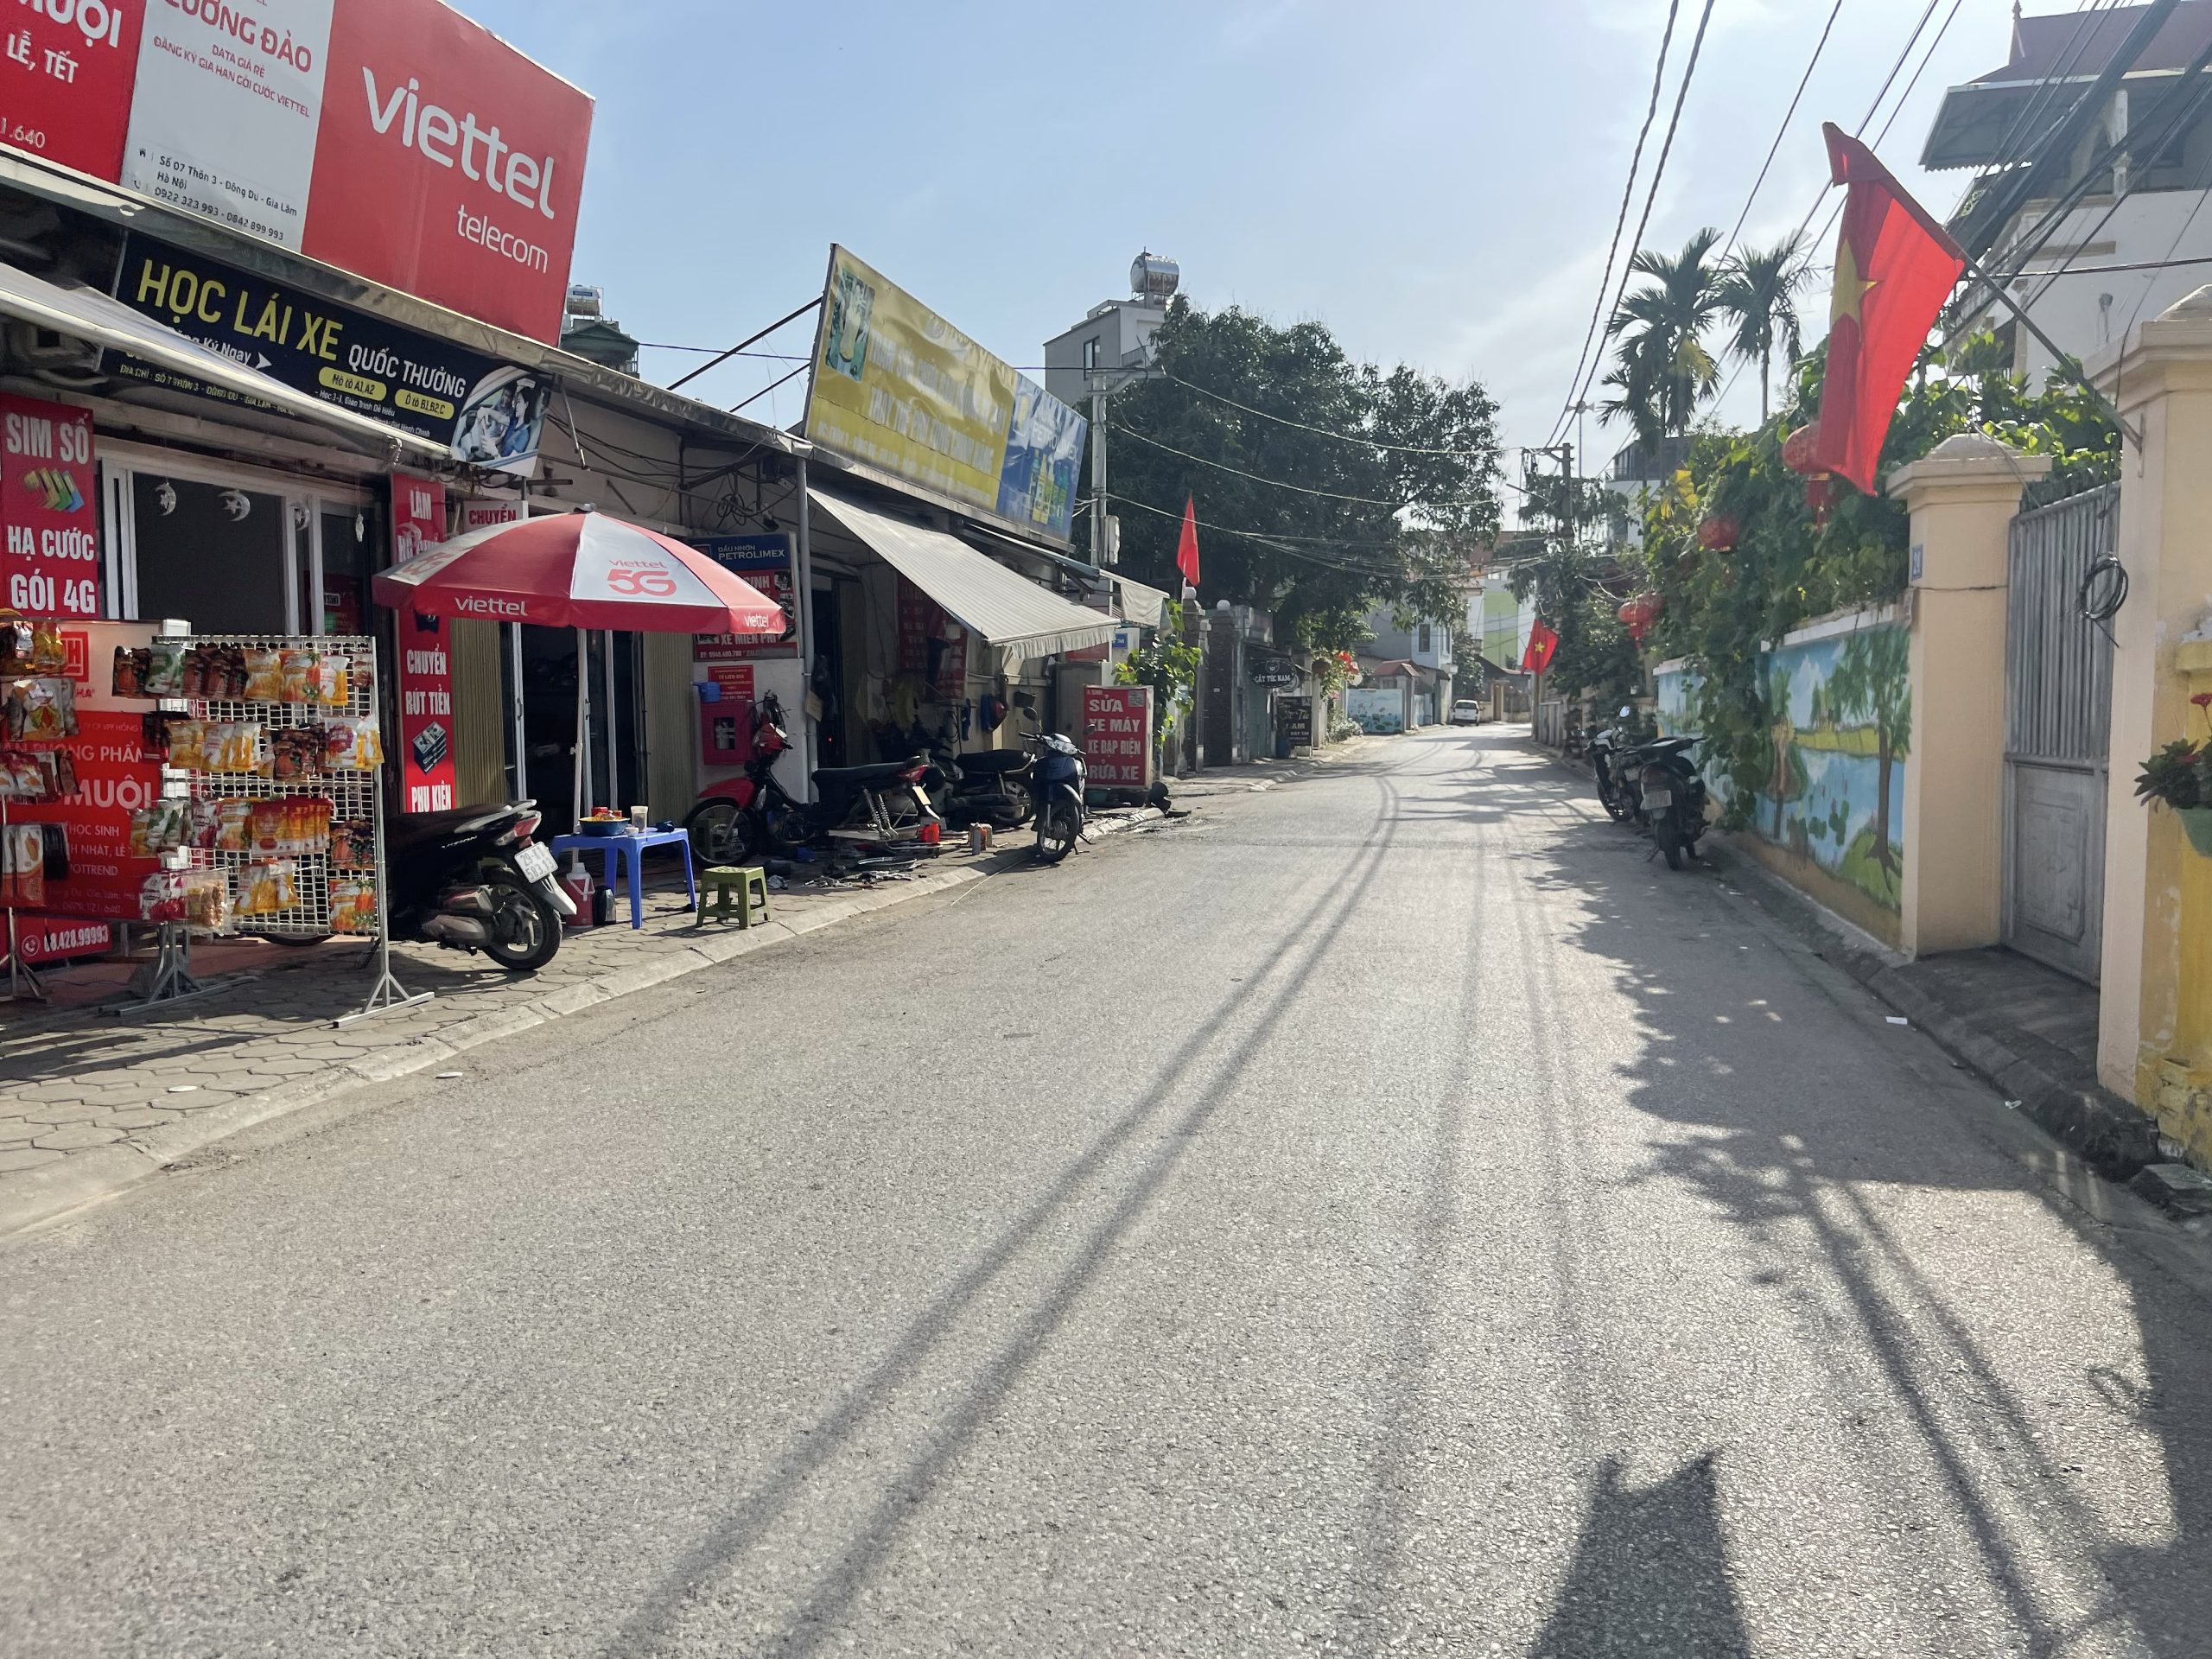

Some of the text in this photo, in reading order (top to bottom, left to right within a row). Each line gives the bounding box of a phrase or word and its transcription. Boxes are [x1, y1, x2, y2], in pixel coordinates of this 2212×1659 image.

[212, 44, 236, 64] DATA
[237, 57, 252, 73] GIÁ
[261, 29, 312, 73] ĐÀO
[44, 48, 79, 84] TẾT
[199, 57, 214, 71] GIA
[276, 93, 310, 118] VIETTEL
[362, 66, 554, 219] viettel
[157, 171, 169, 183] Hà
[159, 156, 171, 168] Số
[173, 161, 186, 172] 07
[188, 165, 209, 181] Thôn
[212, 175, 217, 185] 3
[265, 196, 278, 209] Gia
[280, 204, 297, 216] Lâm
[155, 187, 178, 202] 0922
[201, 202, 219, 216] 993
[268, 227, 283, 240] 993
[457, 204, 548, 273] telecom
[137, 259, 467, 398] HỌC LÁI XE QUỐC THƯỞNG
[5, 412, 90, 465] SIM SỐ
[7, 524, 95, 562] HẠ CƯỚC
[718, 549, 785, 561] PETROLIMEX
[607, 559, 668, 569] viettel
[10, 568, 96, 614] GÓI 4G
[607, 569, 677, 597] 5G
[454, 595, 529, 617] viettel
[744, 613, 769, 628] viettel
[405, 687, 426, 715] RÚT
[1088, 694, 1123, 713] SỬA
[1109, 716, 1141, 733] MÁY
[1087, 739, 1098, 755] XE
[1100, 739, 1119, 758] ĐẠP
[1088, 759, 1140, 780] RỬA XE
[94, 824, 119, 837] SINH
